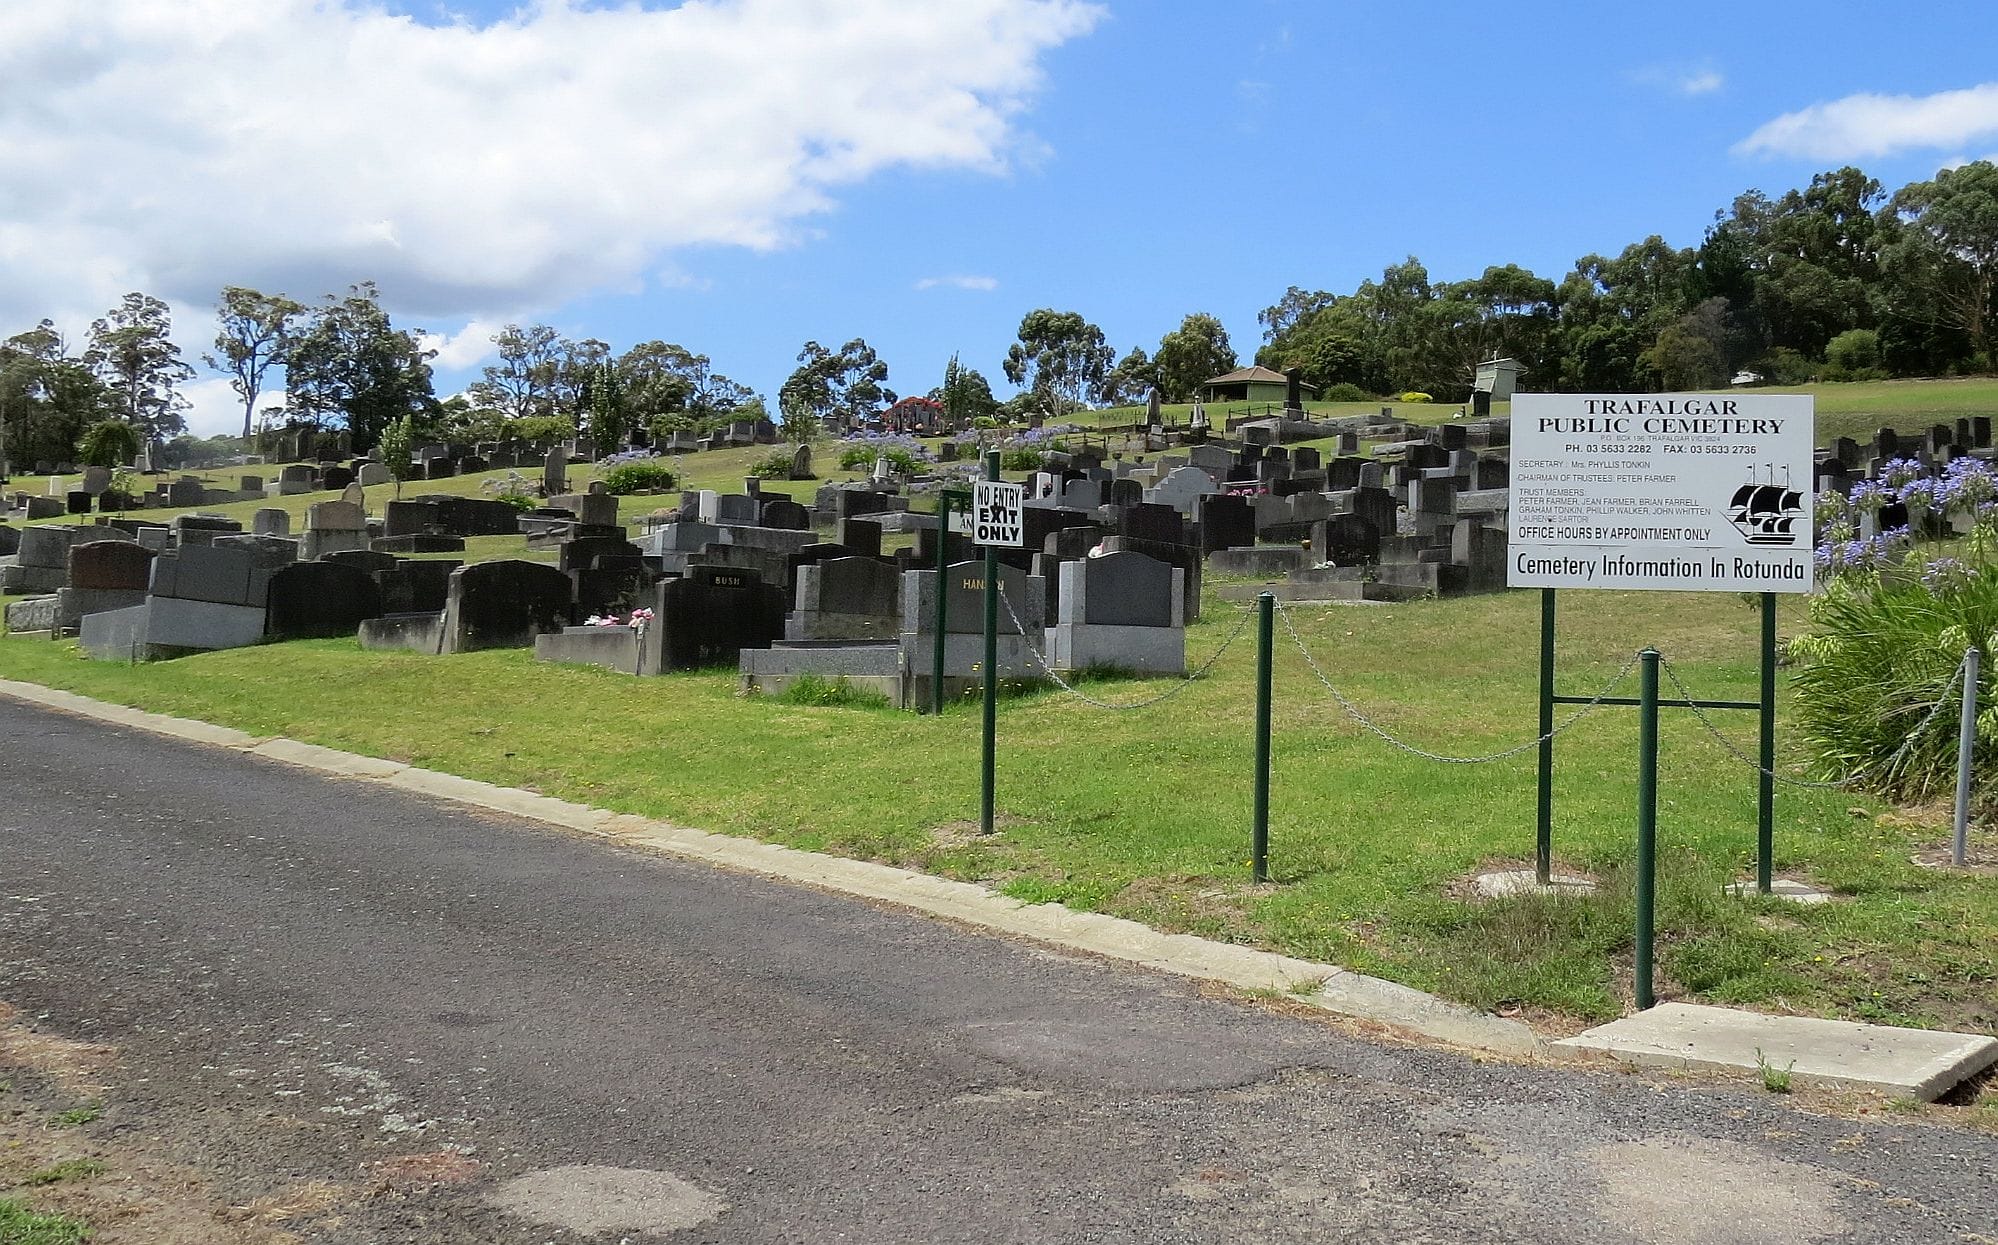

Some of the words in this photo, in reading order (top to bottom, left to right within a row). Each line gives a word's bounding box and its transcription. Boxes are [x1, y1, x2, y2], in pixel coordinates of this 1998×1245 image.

[1584, 399, 1738, 415] TRAFALGAR
[1538, 418, 1630, 433] PUBLIC
[1643, 418, 1785, 434] CEMETERY
[1565, 444, 1583, 453] PH.
[1586, 444, 1598, 453] 03
[1600, 444, 1625, 453] 5633
[1627, 444, 1652, 453] 2282
[1663, 444, 1688, 453] FAX:
[1690, 445, 1703, 454] 03
[1705, 445, 1729, 454] 5633
[1732, 445, 1757, 454] 2736
[1588, 461, 1620, 469] PHYLLIS
[1621, 461, 1651, 469] TONKIN
[1560, 474, 1571, 482] OF
[1617, 474, 1643, 482] PETER
[1644, 475, 1676, 483] FARMER
[977, 485, 990, 505] NO
[993, 487, 1020, 507] ENTRY
[1519, 488, 1544, 496] TRUST
[1518, 497, 1545, 505] PETER
[1582, 498, 1602, 506] JEAN
[1639, 498, 1663, 506] BRIAN
[1664, 499, 1699, 507] FARRELL
[979, 505, 1018, 524] EXIT
[1518, 506, 1552, 514] GRAHAM
[1652, 507, 1674, 516] JOHN
[1675, 507, 1711, 516] WHITTEN
[977, 525, 1020, 541] ONLY
[1518, 526, 1555, 539] OFFICE
[1556, 527, 1593, 539] HOURS
[1595, 527, 1609, 539] BY
[1609, 527, 1682, 540] APPOINTMENT
[1683, 528, 1711, 540] ONLY
[1517, 553, 1597, 581] Cemetery
[1602, 554, 1702, 577] Information
[1711, 556, 1725, 577] In
[1733, 557, 1804, 579] Rotunda
[715, 576, 740, 585] BUSH
